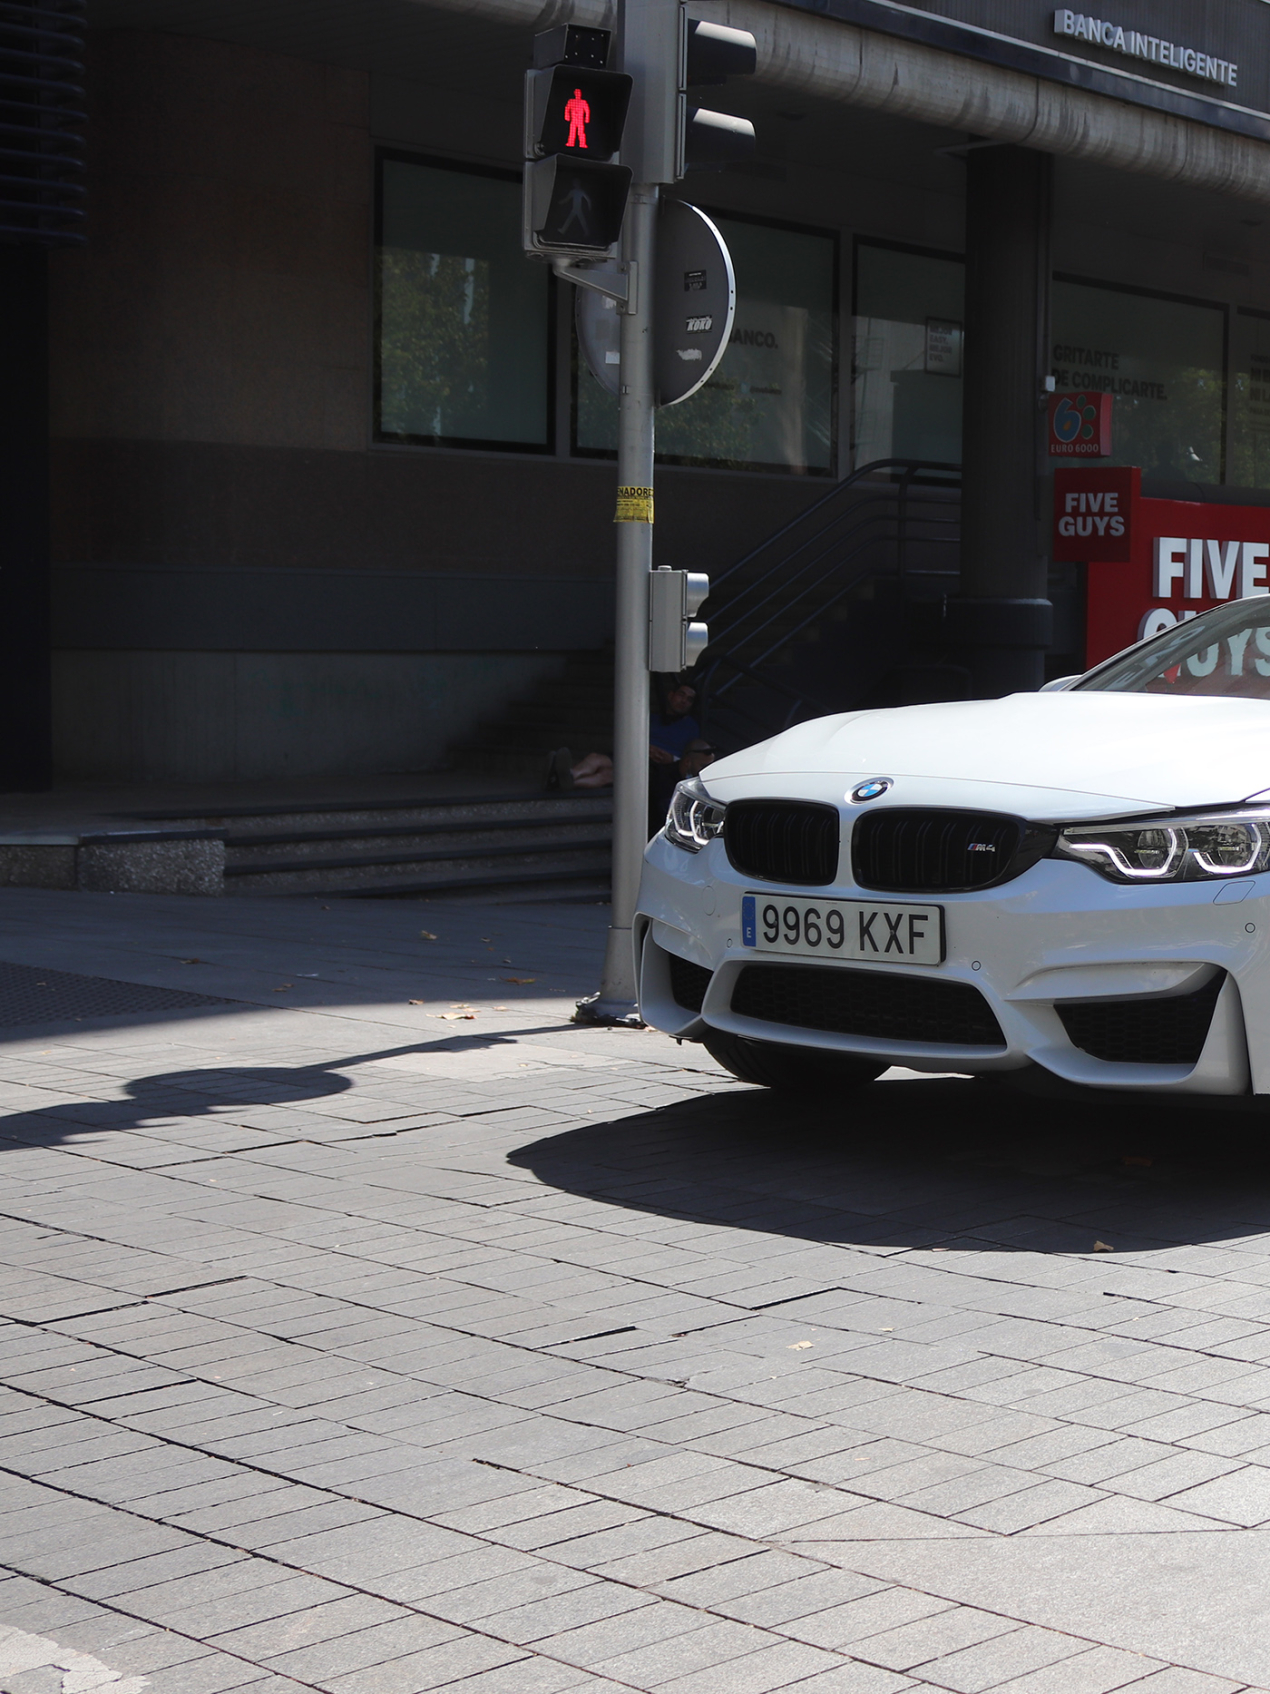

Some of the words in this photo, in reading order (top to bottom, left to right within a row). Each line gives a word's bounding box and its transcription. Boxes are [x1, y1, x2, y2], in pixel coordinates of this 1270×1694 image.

[1054, 9, 1126, 50] BANCA
[1127, 31, 1238, 87] INTELIGENTE
[1053, 343, 1120, 371] GRITARTE
[1052, 367, 1069, 388] DE
[1072, 371, 1168, 401] COMPLICARTE.
[1051, 443, 1074, 453] EURO
[1075, 443, 1100, 453] 6000
[1065, 492, 1119, 513] FIVE
[1058, 516, 1126, 537] GUYS
[1153, 536, 1270, 599] FIVE
[746, 927, 752, 939] E
[763, 904, 845, 949] 9969
[859, 911, 929, 955] KXF
